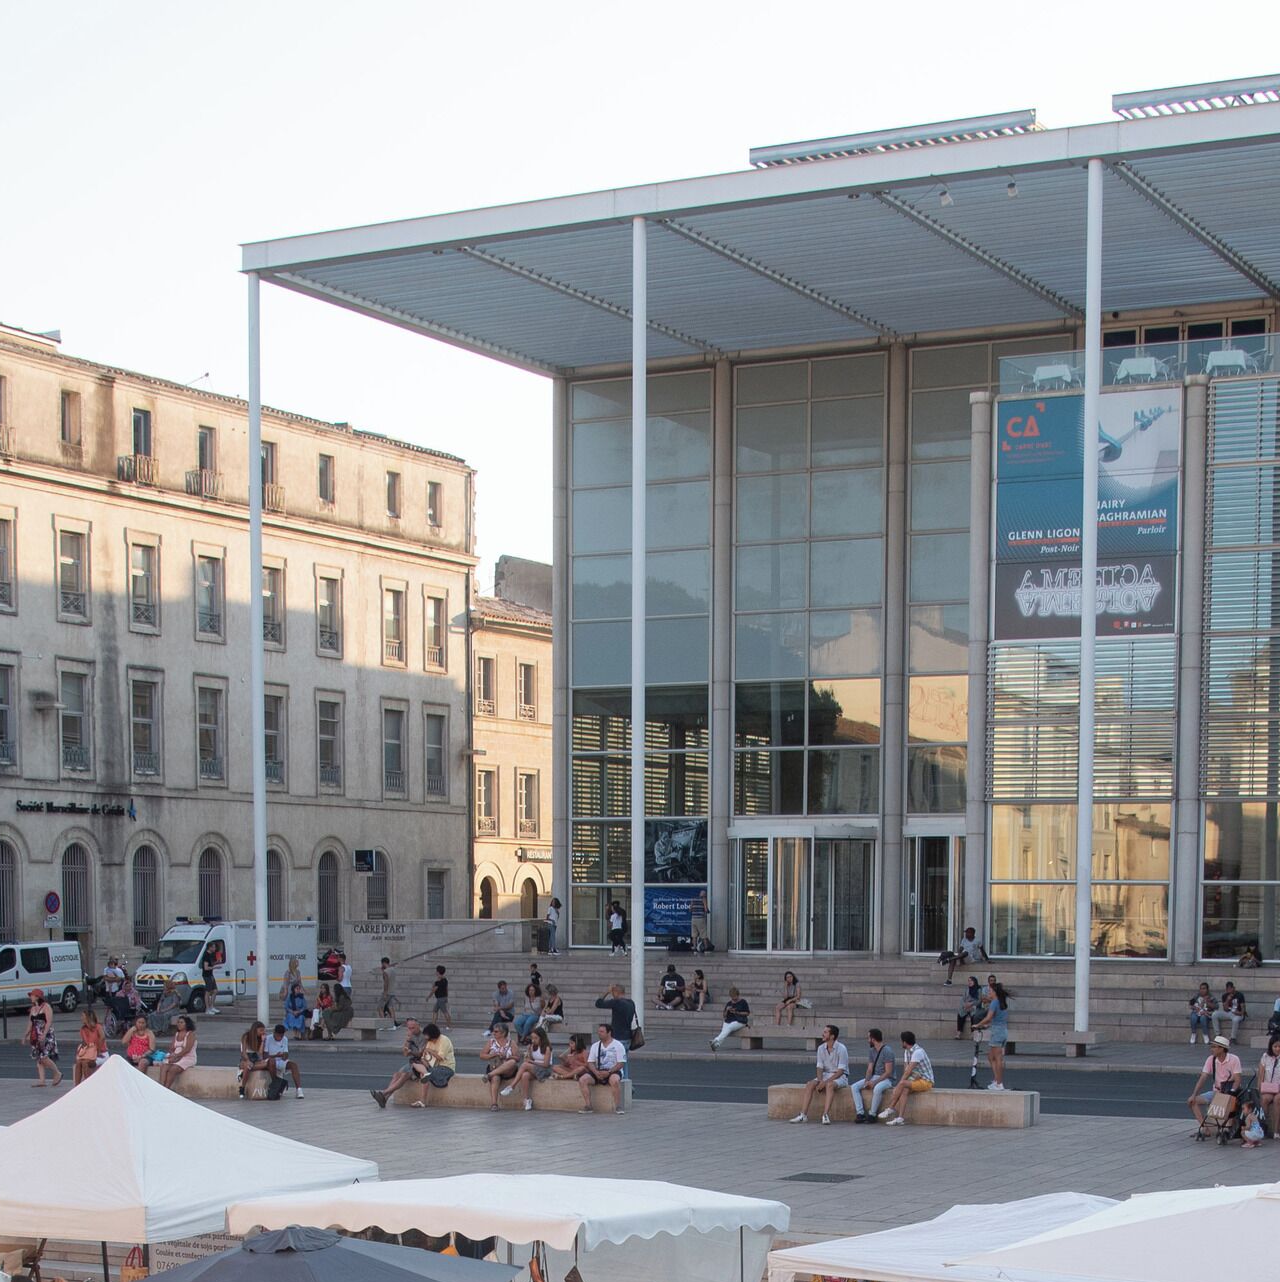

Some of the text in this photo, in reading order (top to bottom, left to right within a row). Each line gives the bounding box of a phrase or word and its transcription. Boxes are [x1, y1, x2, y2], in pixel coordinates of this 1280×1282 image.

[1097, 509, 1167, 521] AGHRAMIAN
[1008, 527, 1081, 541] GLENN LIGON
[1136, 524, 1167, 535] Parloir
[1040, 543, 1080, 553] Post-Noir
[653, 902, 675, 910] Robert
[381, 923, 406, 934] D'ART
[51, 953, 80, 963] LOGISTIQUE
